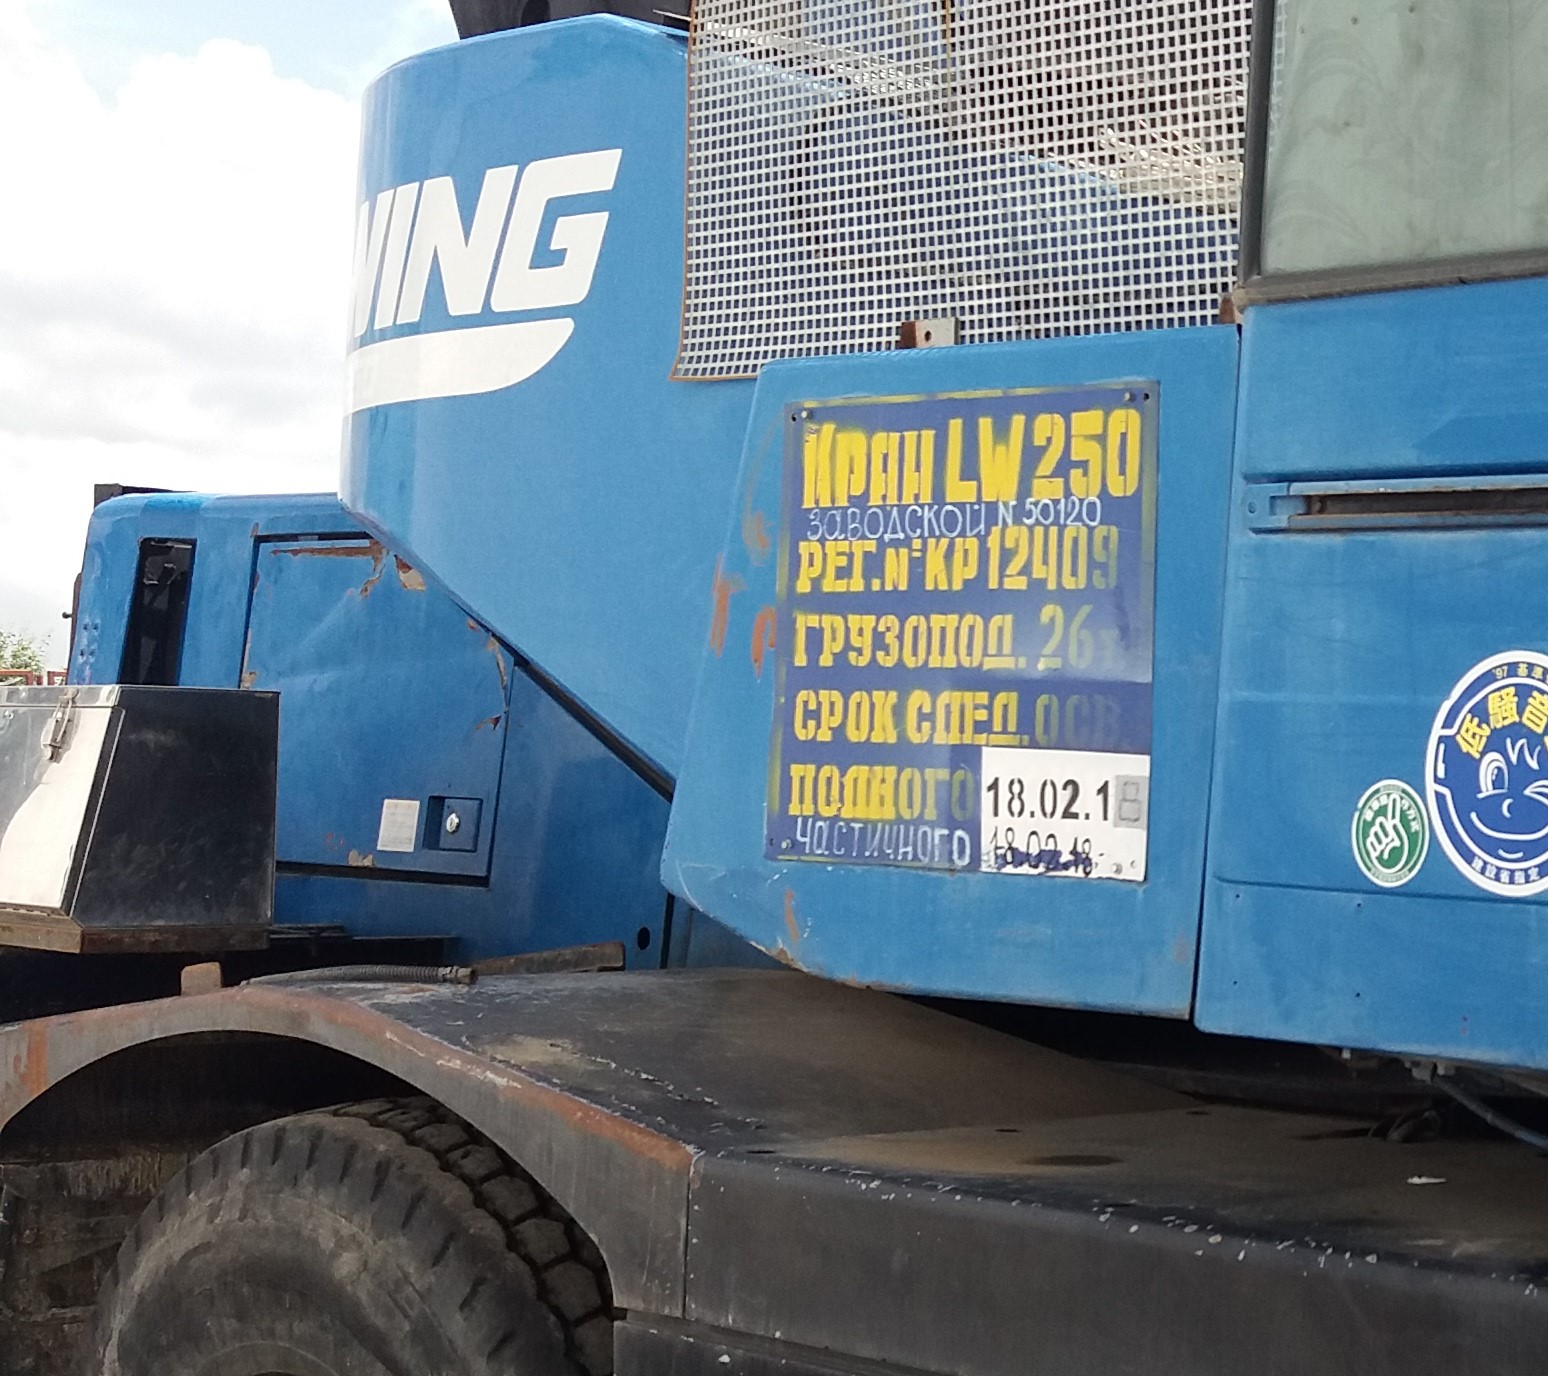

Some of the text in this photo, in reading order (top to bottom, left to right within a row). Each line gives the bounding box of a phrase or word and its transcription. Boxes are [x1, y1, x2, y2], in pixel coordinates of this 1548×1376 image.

[1021, 495, 1102, 528] 50120
[793, 689, 899, 744] СРОК
[788, 763, 976, 823] ПОЛНОГО
